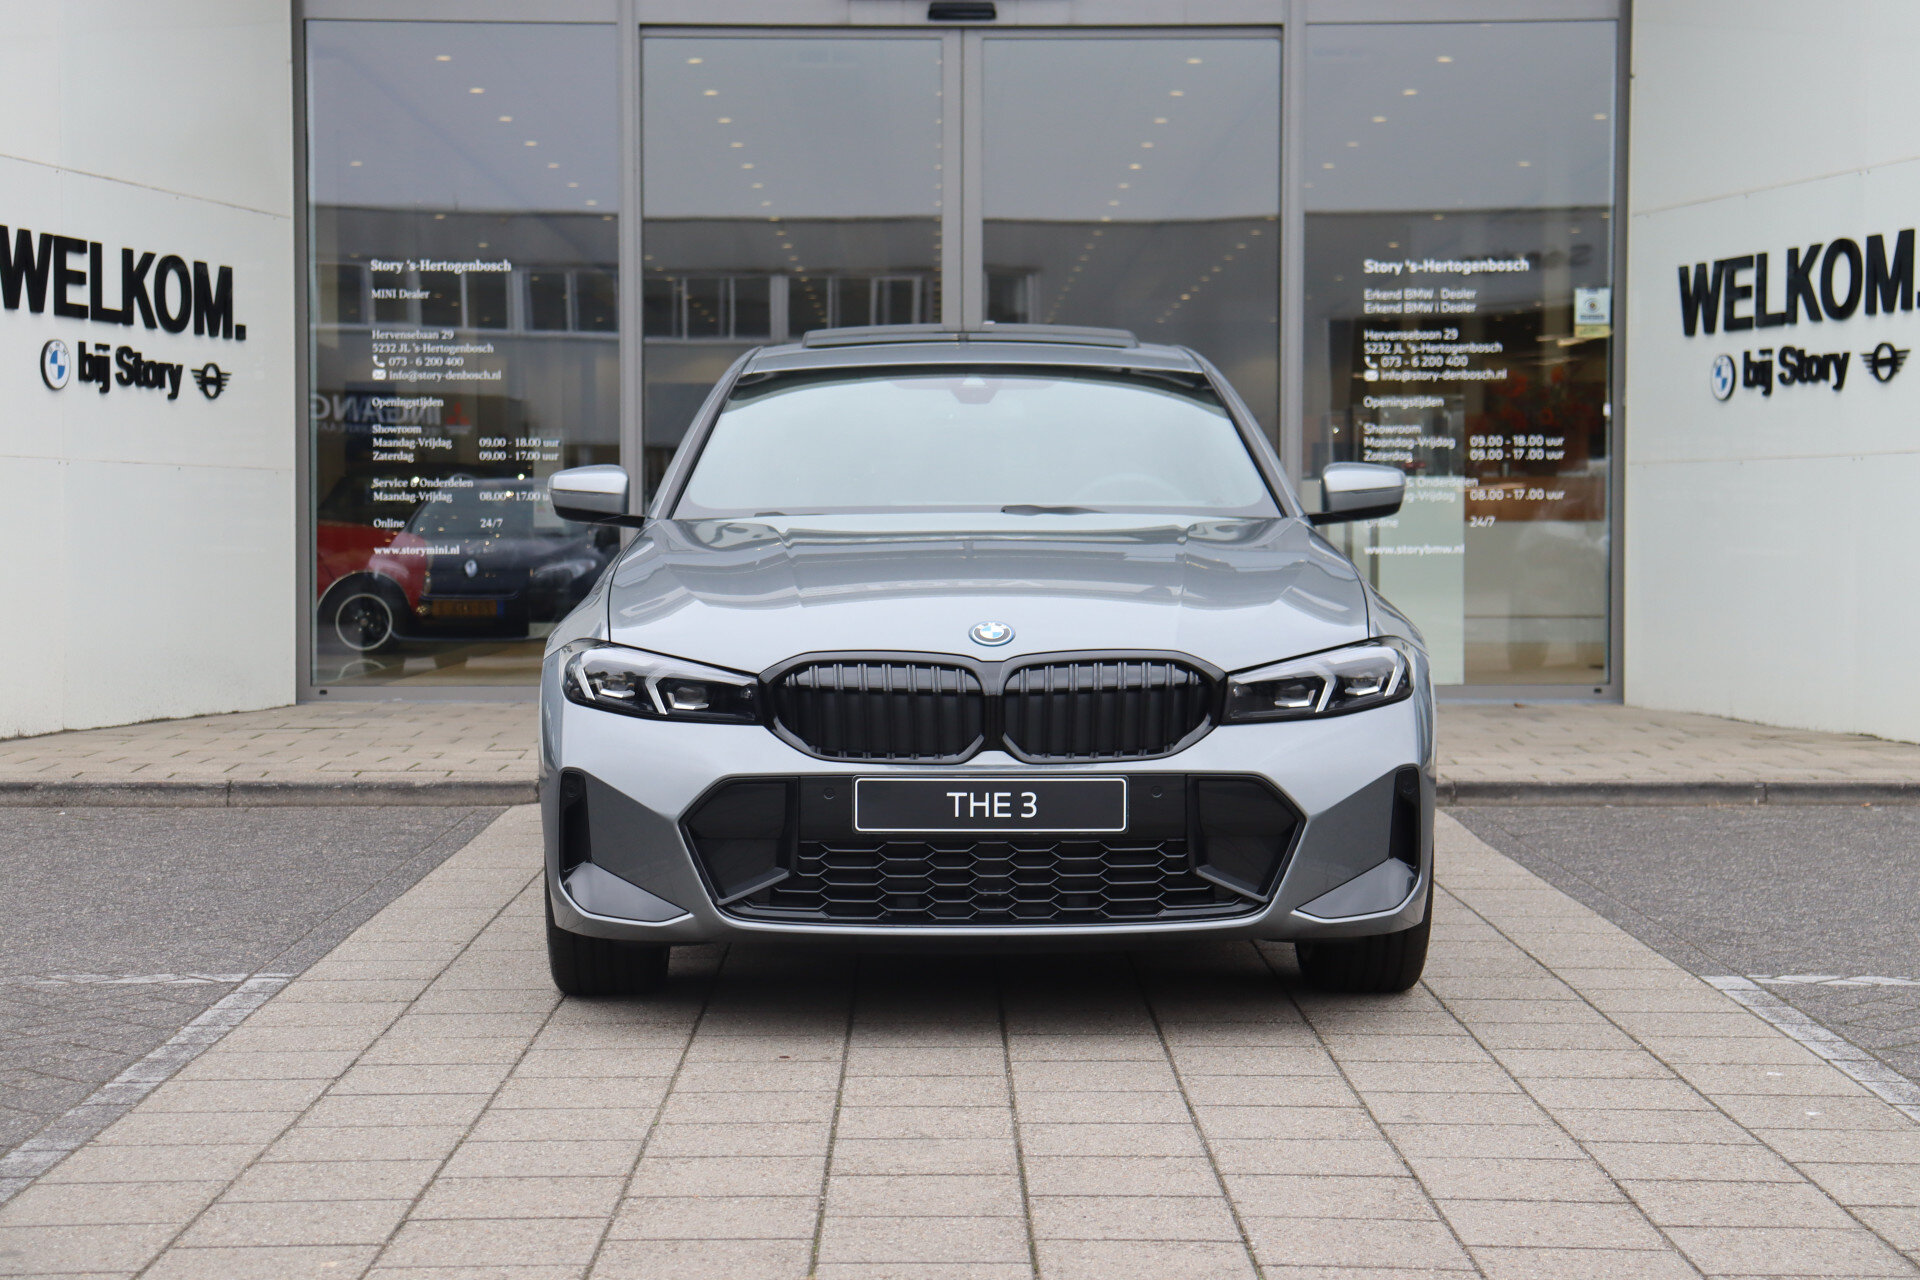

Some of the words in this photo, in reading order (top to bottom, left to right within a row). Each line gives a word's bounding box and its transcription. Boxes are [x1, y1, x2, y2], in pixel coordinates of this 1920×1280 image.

[371, 259, 403, 274] Story
[407, 259, 512, 274] 's-Hertogenbosch
[1363, 259, 1403, 275] Story
[1405, 258, 1530, 275] 's-Hertogenbosch
[0, 225, 246, 341] WELKOM.
[371, 288, 397, 299] MINI
[399, 288, 430, 299] Dealer
[1363, 288, 1402, 300] Erkend
[1404, 288, 1434, 300] BMW
[1440, 288, 1477, 300] Dealer
[1363, 302, 1402, 314] Erkend
[1404, 302, 1434, 314] BMW
[1440, 302, 1477, 314] Dealer
[371, 330, 439, 340] Hervensebaan
[441, 329, 454, 340] 29
[1363, 328, 1442, 340] Hervensebaan
[1443, 328, 1459, 340] 29
[372, 343, 396, 353] 5232
[1363, 342, 1391, 354] 5232
[388, 356, 407, 367] 073
[415, 356, 422, 367] 6
[425, 356, 443, 367] 200
[445, 356, 464, 367] 400
[1381, 355, 1402, 367] 073
[1411, 355, 1420, 367] 6
[1421, 355, 1444, 367] 200
[1445, 355, 1468, 367] 400
[78, 341, 110, 394] bij
[115, 346, 183, 400] Story
[389, 368, 501, 382] info@story-denbosch.nl
[1381, 368, 1507, 382] info@story-denbosch.nl
[1743, 350, 1773, 398] bij
[1778, 345, 1850, 393] Story
[372, 397, 444, 409] Openingstijden
[1363, 395, 1444, 409] Openingstijden
[372, 424, 422, 434] Showroom
[1363, 423, 1421, 434] Showroom
[372, 437, 453, 449] Maandag-Vrijdag
[479, 437, 506, 448] 09.00
[515, 437, 541, 448] 18.00
[543, 439, 560, 448] uur
[1363, 437, 1456, 449] Maandag-Vrijdag
[1469, 435, 1503, 448] 09.00
[1513, 435, 1544, 447] 18.00
[1546, 437, 1565, 447] uur
[372, 450, 414, 463] Zaterdag
[479, 450, 506, 461] 09.00
[515, 450, 540, 461] 17.00
[542, 453, 559, 461] uur
[1363, 450, 1413, 463] Zaterdag
[1469, 449, 1503, 461] 09.00
[1546, 451, 1565, 461] uur
[372, 477, 408, 488] Service
[420, 477, 474, 488] Onderdelen
[373, 491, 453, 503] Maandag-Vrijdag
[479, 491, 506, 501] 08.00
[515, 491, 540, 501] 17.00
[1470, 488, 1504, 500] 08.00
[1546, 490, 1565, 500] uur
[373, 518, 405, 528] Online
[480, 518, 503, 528] 24/7
[1469, 516, 1496, 527] 24/7
[373, 545, 460, 557] www.storymini.nl
[946, 791, 1012, 818] THE
[1020, 791, 1037, 818] 3
